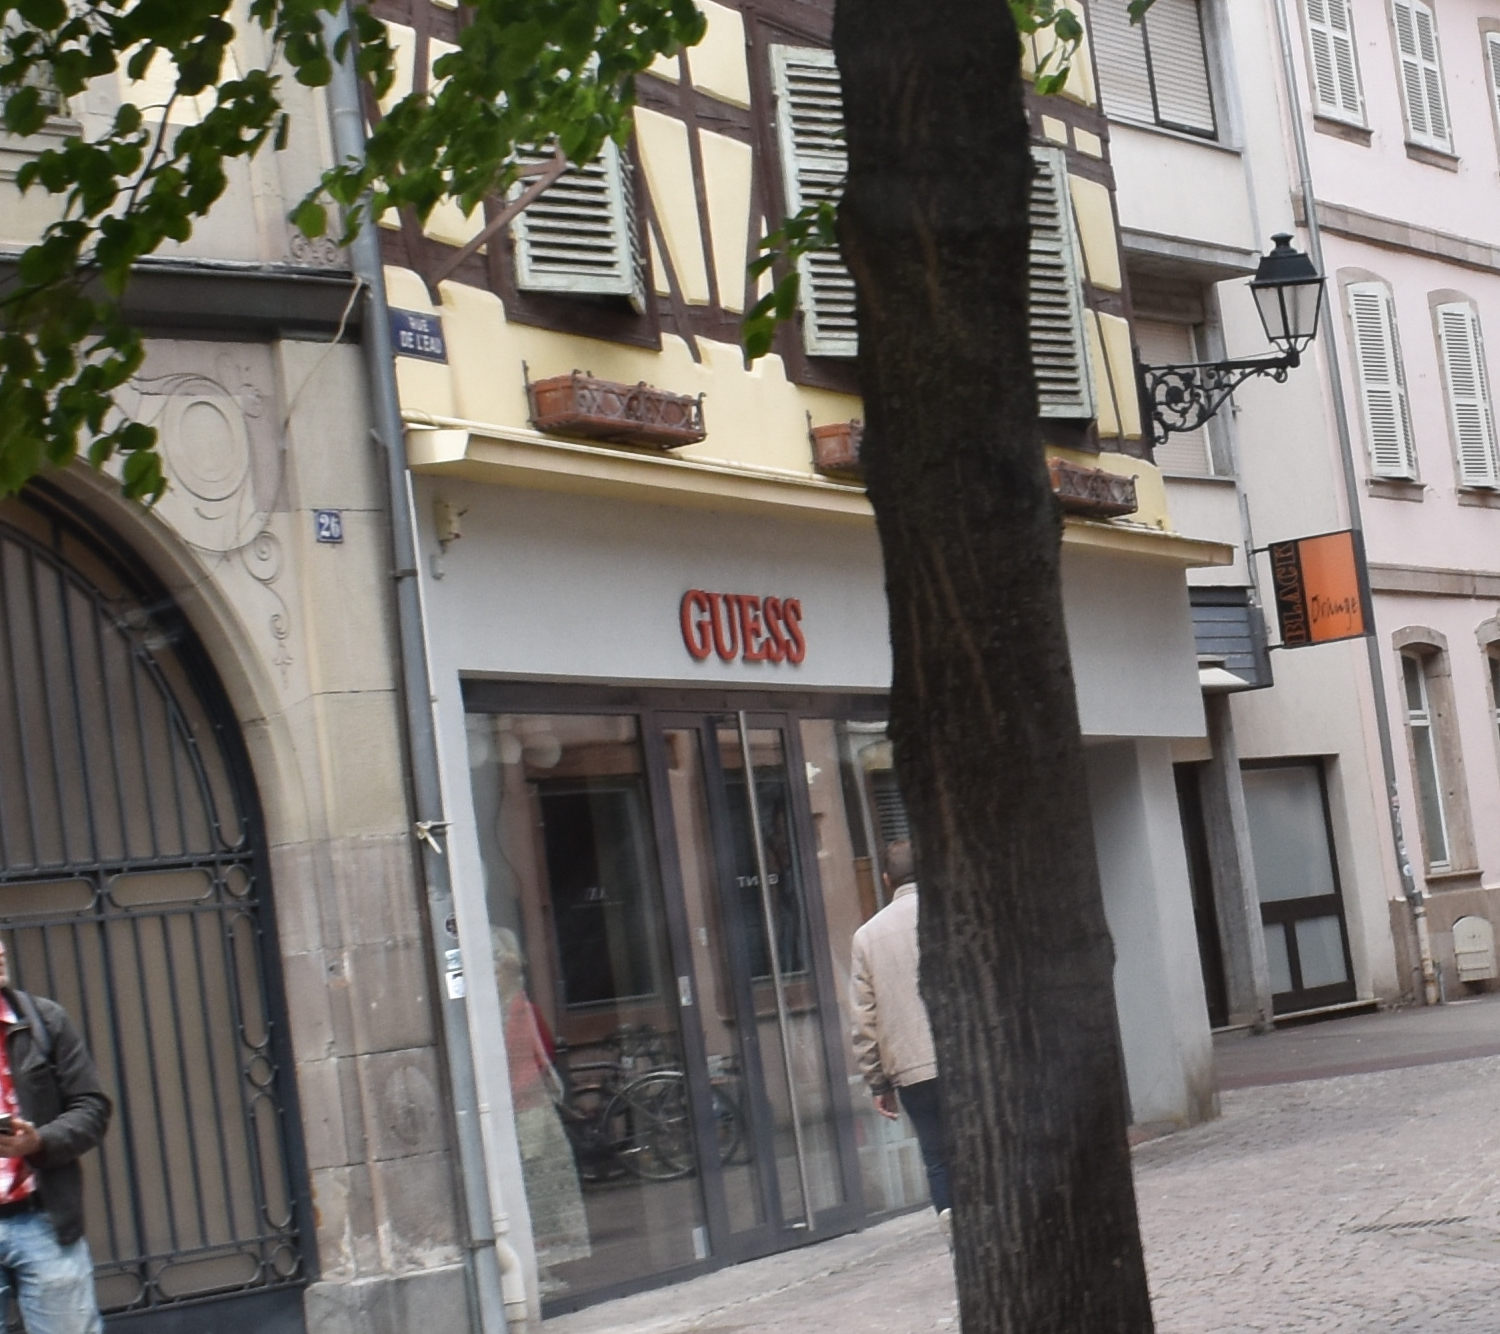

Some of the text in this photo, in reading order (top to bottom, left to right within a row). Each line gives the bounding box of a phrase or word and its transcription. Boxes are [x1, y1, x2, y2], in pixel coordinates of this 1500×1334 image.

[408, 317, 429, 332] RUE
[400, 331, 442, 354] DE L'EAU
[319, 514, 341, 538] 26
[1272, 542, 1307, 646] BLACK
[680, 588, 806, 665] GUESS
[1311, 595, 1357, 631] Orange
